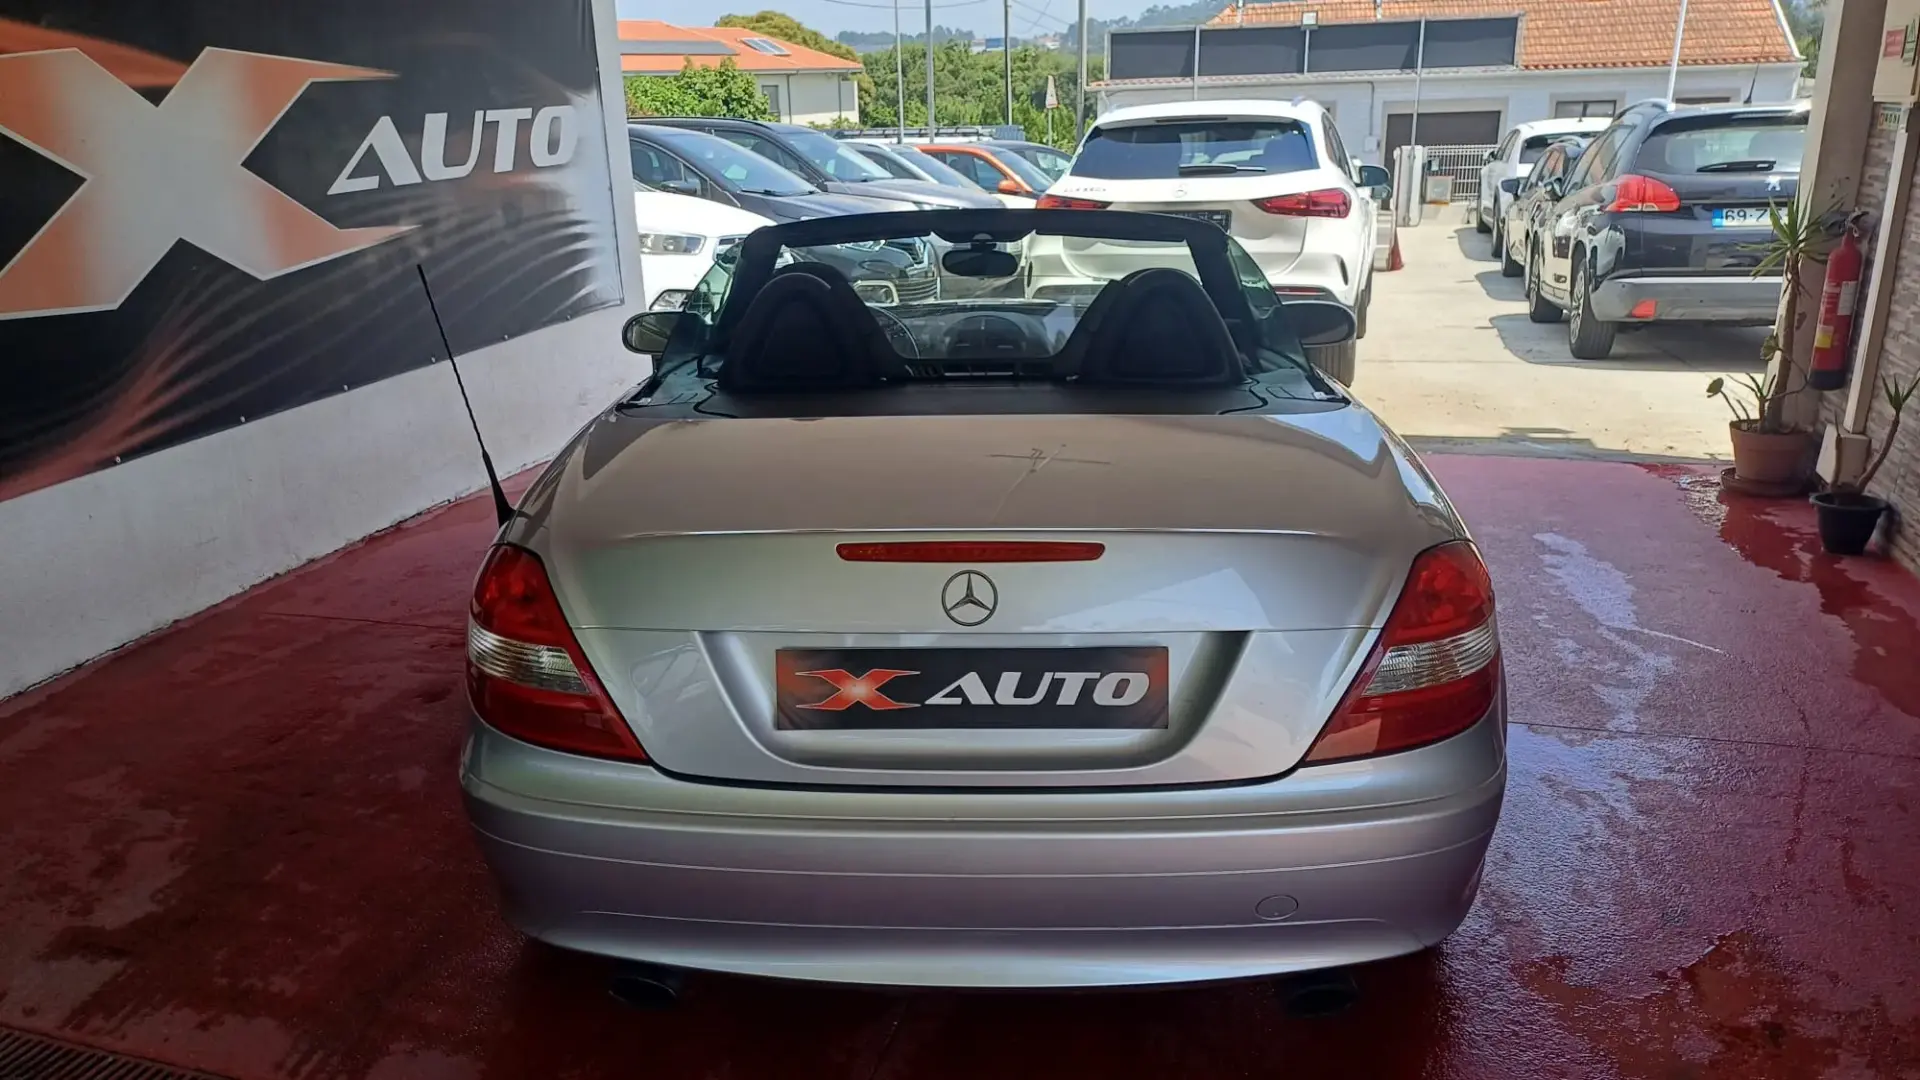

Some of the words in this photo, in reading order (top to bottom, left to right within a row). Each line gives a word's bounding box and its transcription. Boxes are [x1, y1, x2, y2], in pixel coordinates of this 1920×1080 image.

[0, 46, 421, 320] X
[326, 105, 580, 195] AUTO
[795, 668, 921, 710] X
[924, 671, 1150, 706] AUTO
